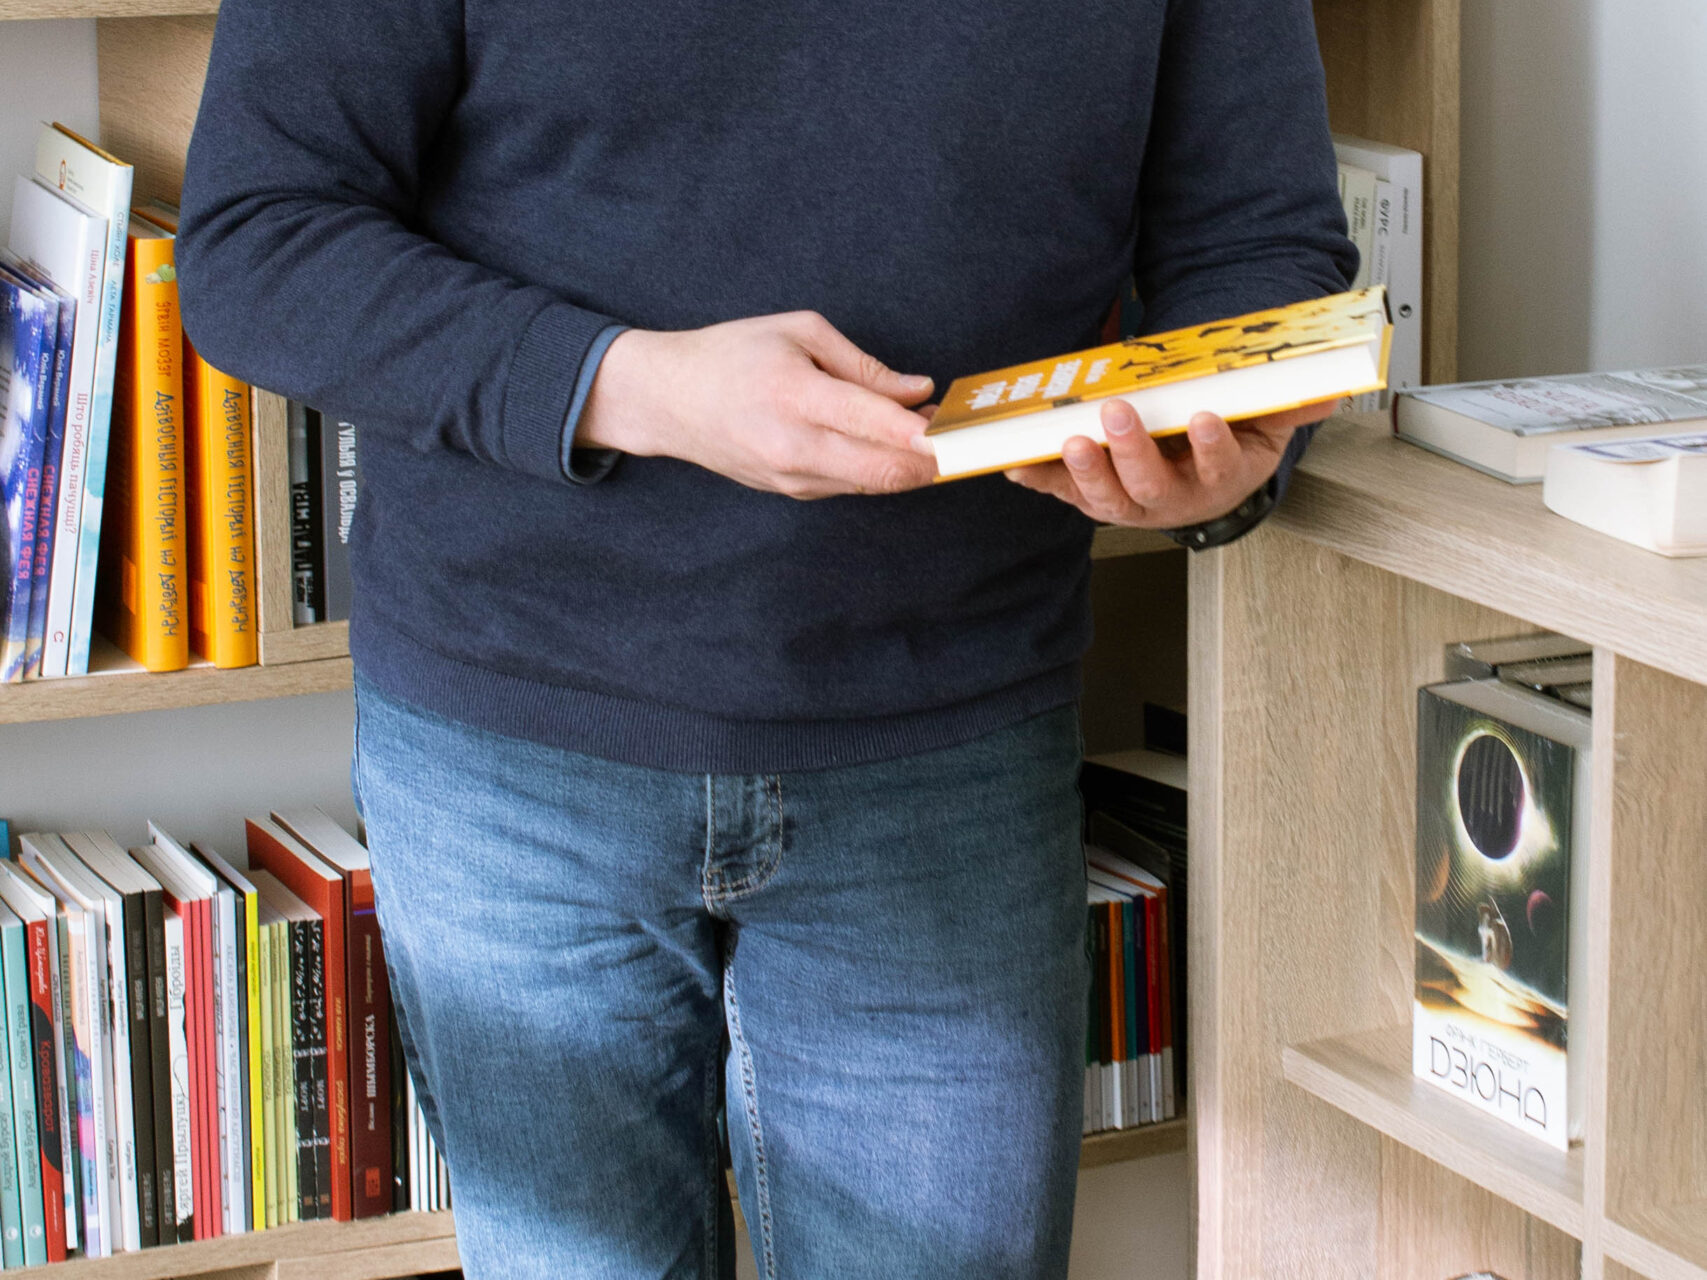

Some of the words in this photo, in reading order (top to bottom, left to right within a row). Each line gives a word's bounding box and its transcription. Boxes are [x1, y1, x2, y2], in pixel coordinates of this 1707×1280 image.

[75, 391, 88, 420] Што
[69, 423, 84, 470] робяць
[22, 466, 39, 541] СНЕЖНАЯ
[36, 464, 55, 540] СНЕЖНАЯ
[64, 473, 80, 534] пачуцці?
[18, 545, 33, 579] ФЕЯ
[34, 542, 50, 576] ФЕЯ
[1430, 1035, 1547, 1130] ДЗЮНА
